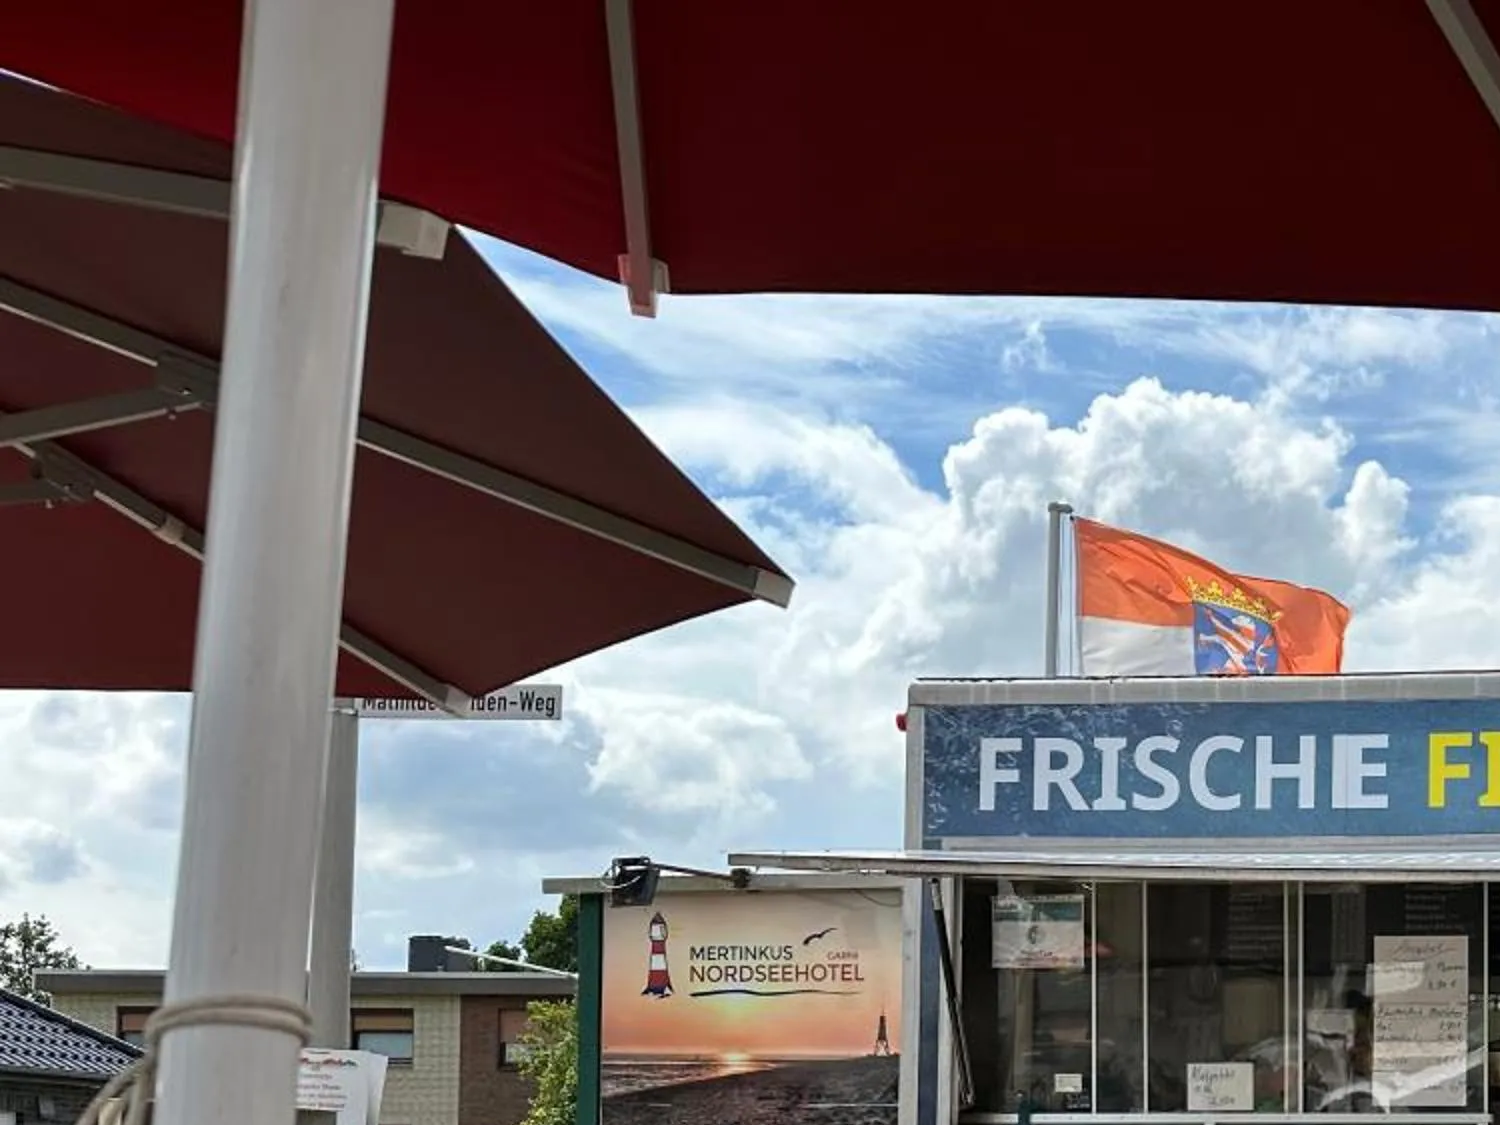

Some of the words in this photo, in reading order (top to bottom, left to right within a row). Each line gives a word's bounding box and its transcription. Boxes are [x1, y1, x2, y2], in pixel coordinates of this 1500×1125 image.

[977, 732, 1390, 813] FRISCHE
[689, 944, 794, 962] MERTINKUS
[689, 963, 865, 983] NORDSEEHOTEL
